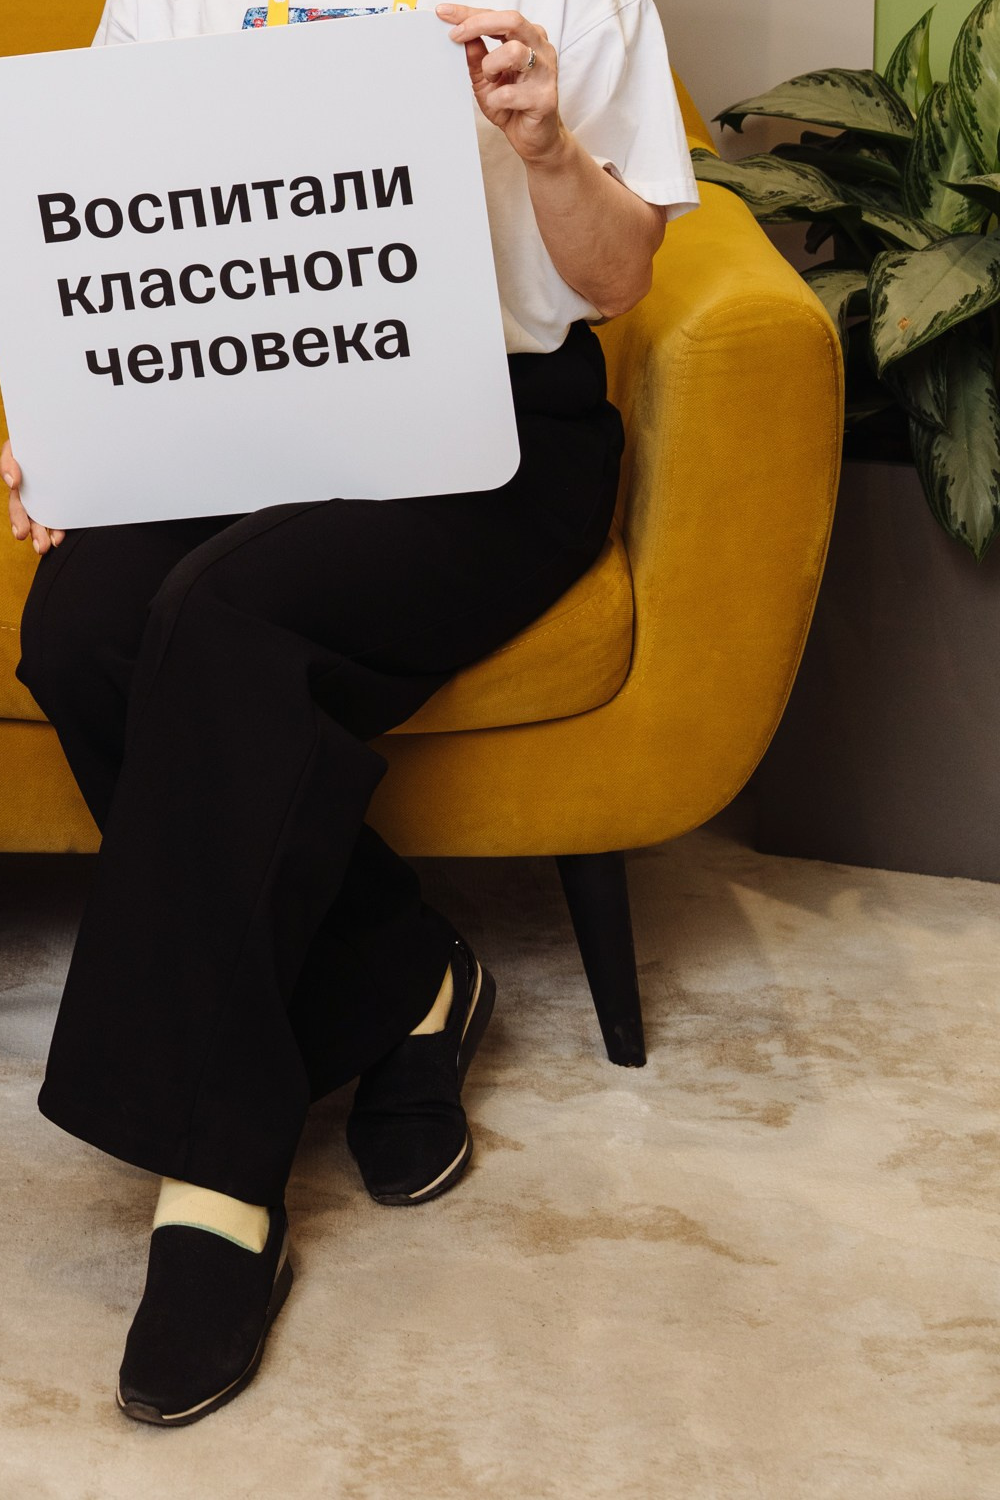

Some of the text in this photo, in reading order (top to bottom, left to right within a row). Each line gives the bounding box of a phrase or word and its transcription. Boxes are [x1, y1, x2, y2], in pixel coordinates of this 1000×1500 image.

[37, 165, 415, 244] Воспитали
[56, 242, 419, 317] классного
[85, 318, 411, 386] человека
